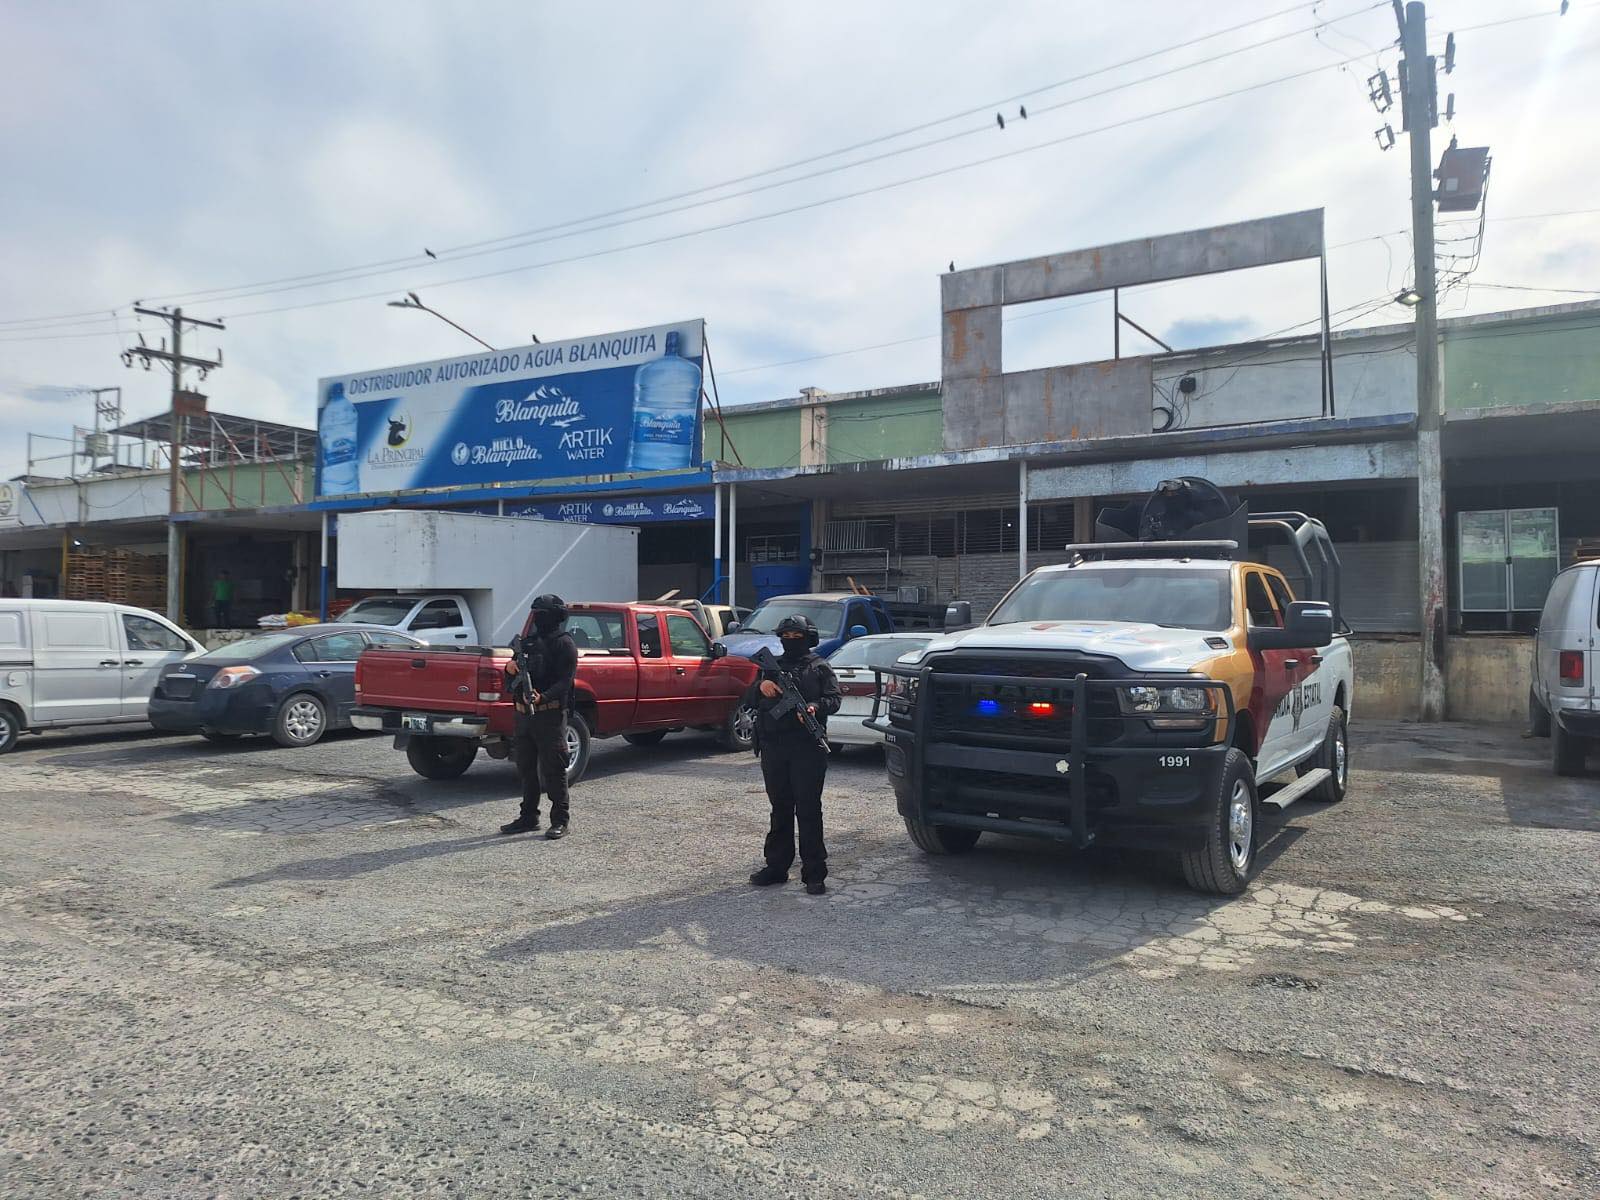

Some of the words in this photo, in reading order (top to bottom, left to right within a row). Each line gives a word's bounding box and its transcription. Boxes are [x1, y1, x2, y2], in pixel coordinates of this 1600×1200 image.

[349, 368, 432, 395] DISTRIBUIDOR
[436, 354, 520, 383] AUTORIZADO
[523, 347, 564, 370] AGUA
[568, 334, 657, 363] BLANQUITA
[495, 395, 580, 426] Blanquita
[558, 427, 613, 450] ARTIK
[471, 444, 538, 467] Blanquita
[566, 447, 605, 461] WATER
[558, 503, 593, 515] ARTIK
[563, 514, 588, 523] WATER
[1158, 756, 1191, 768] 1991
